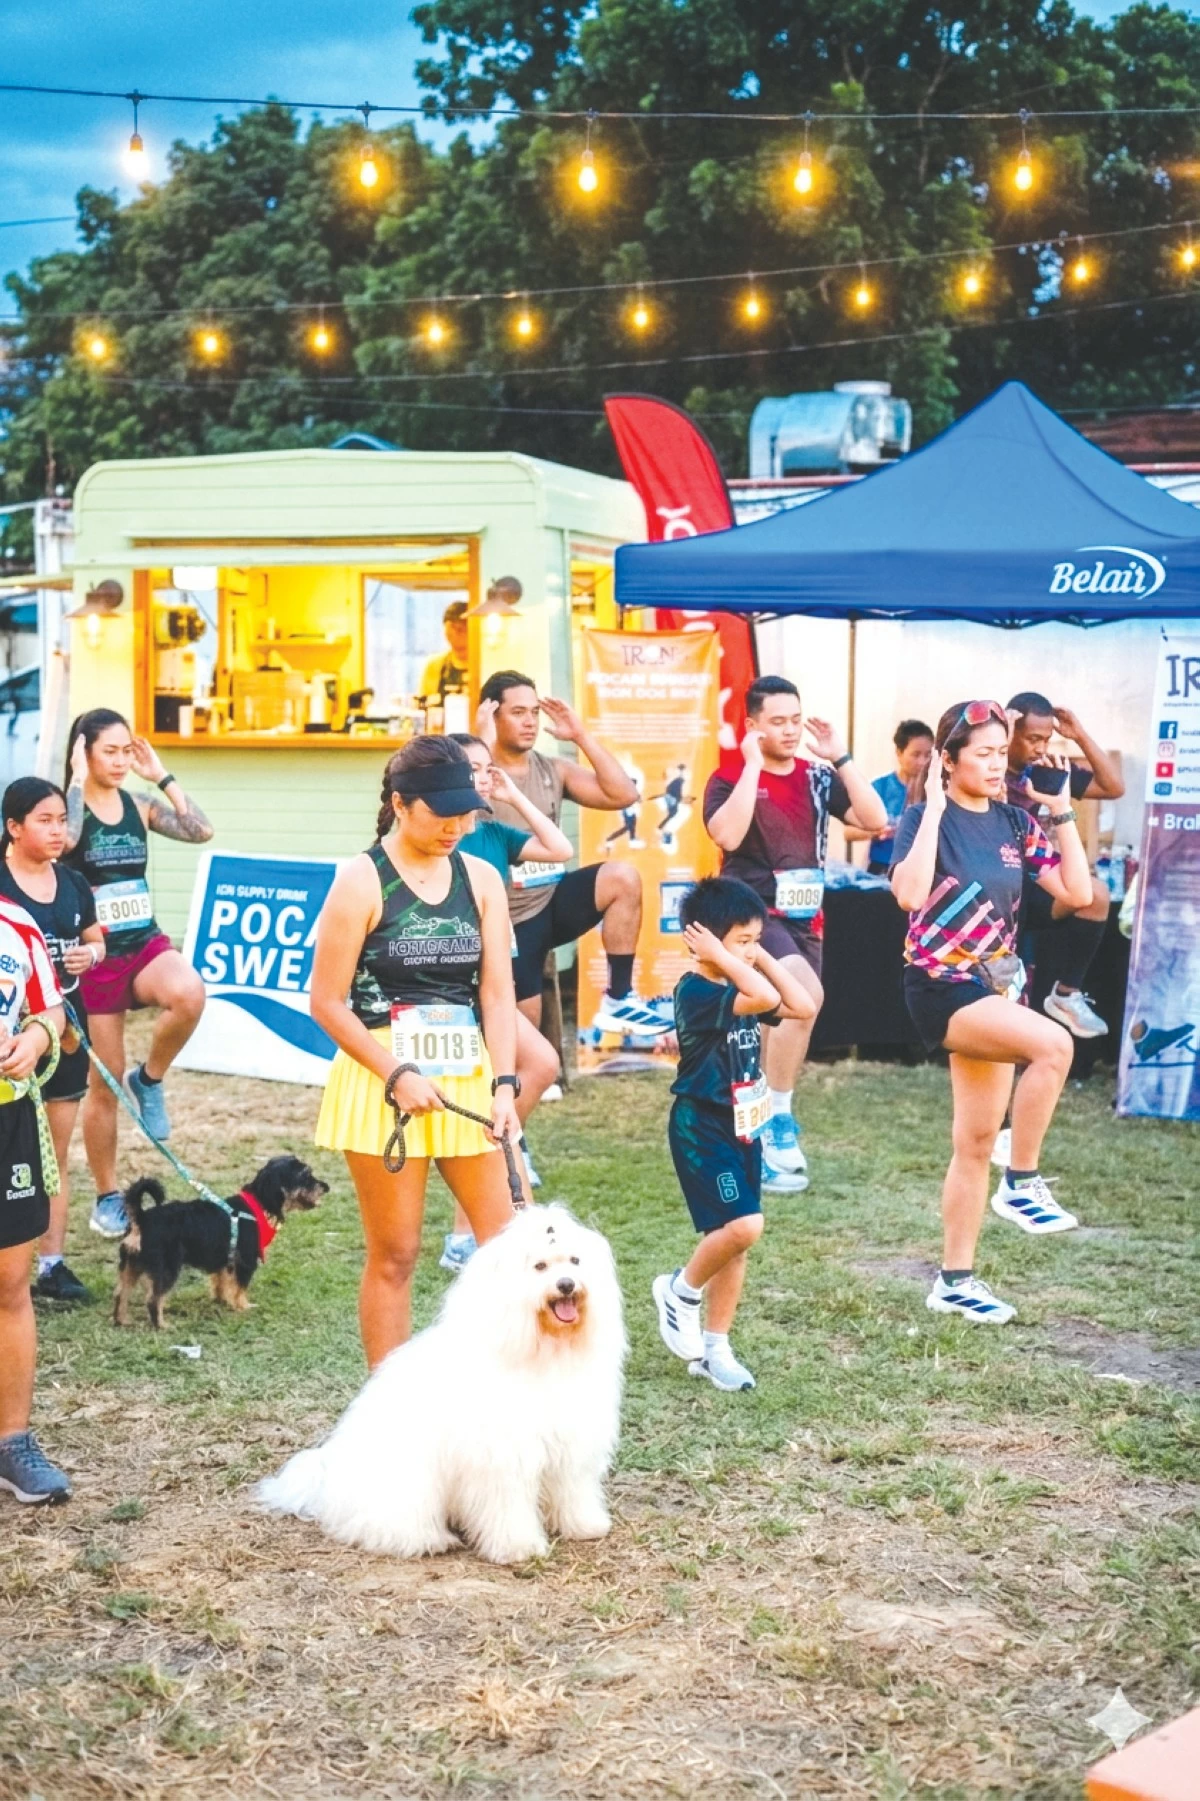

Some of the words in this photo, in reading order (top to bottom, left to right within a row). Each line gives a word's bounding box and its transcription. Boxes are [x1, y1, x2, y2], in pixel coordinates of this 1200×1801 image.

[1048, 560, 1147, 594] Belair
[236, 885, 276, 899] SUPPLY
[200, 941, 314, 992] SWE
